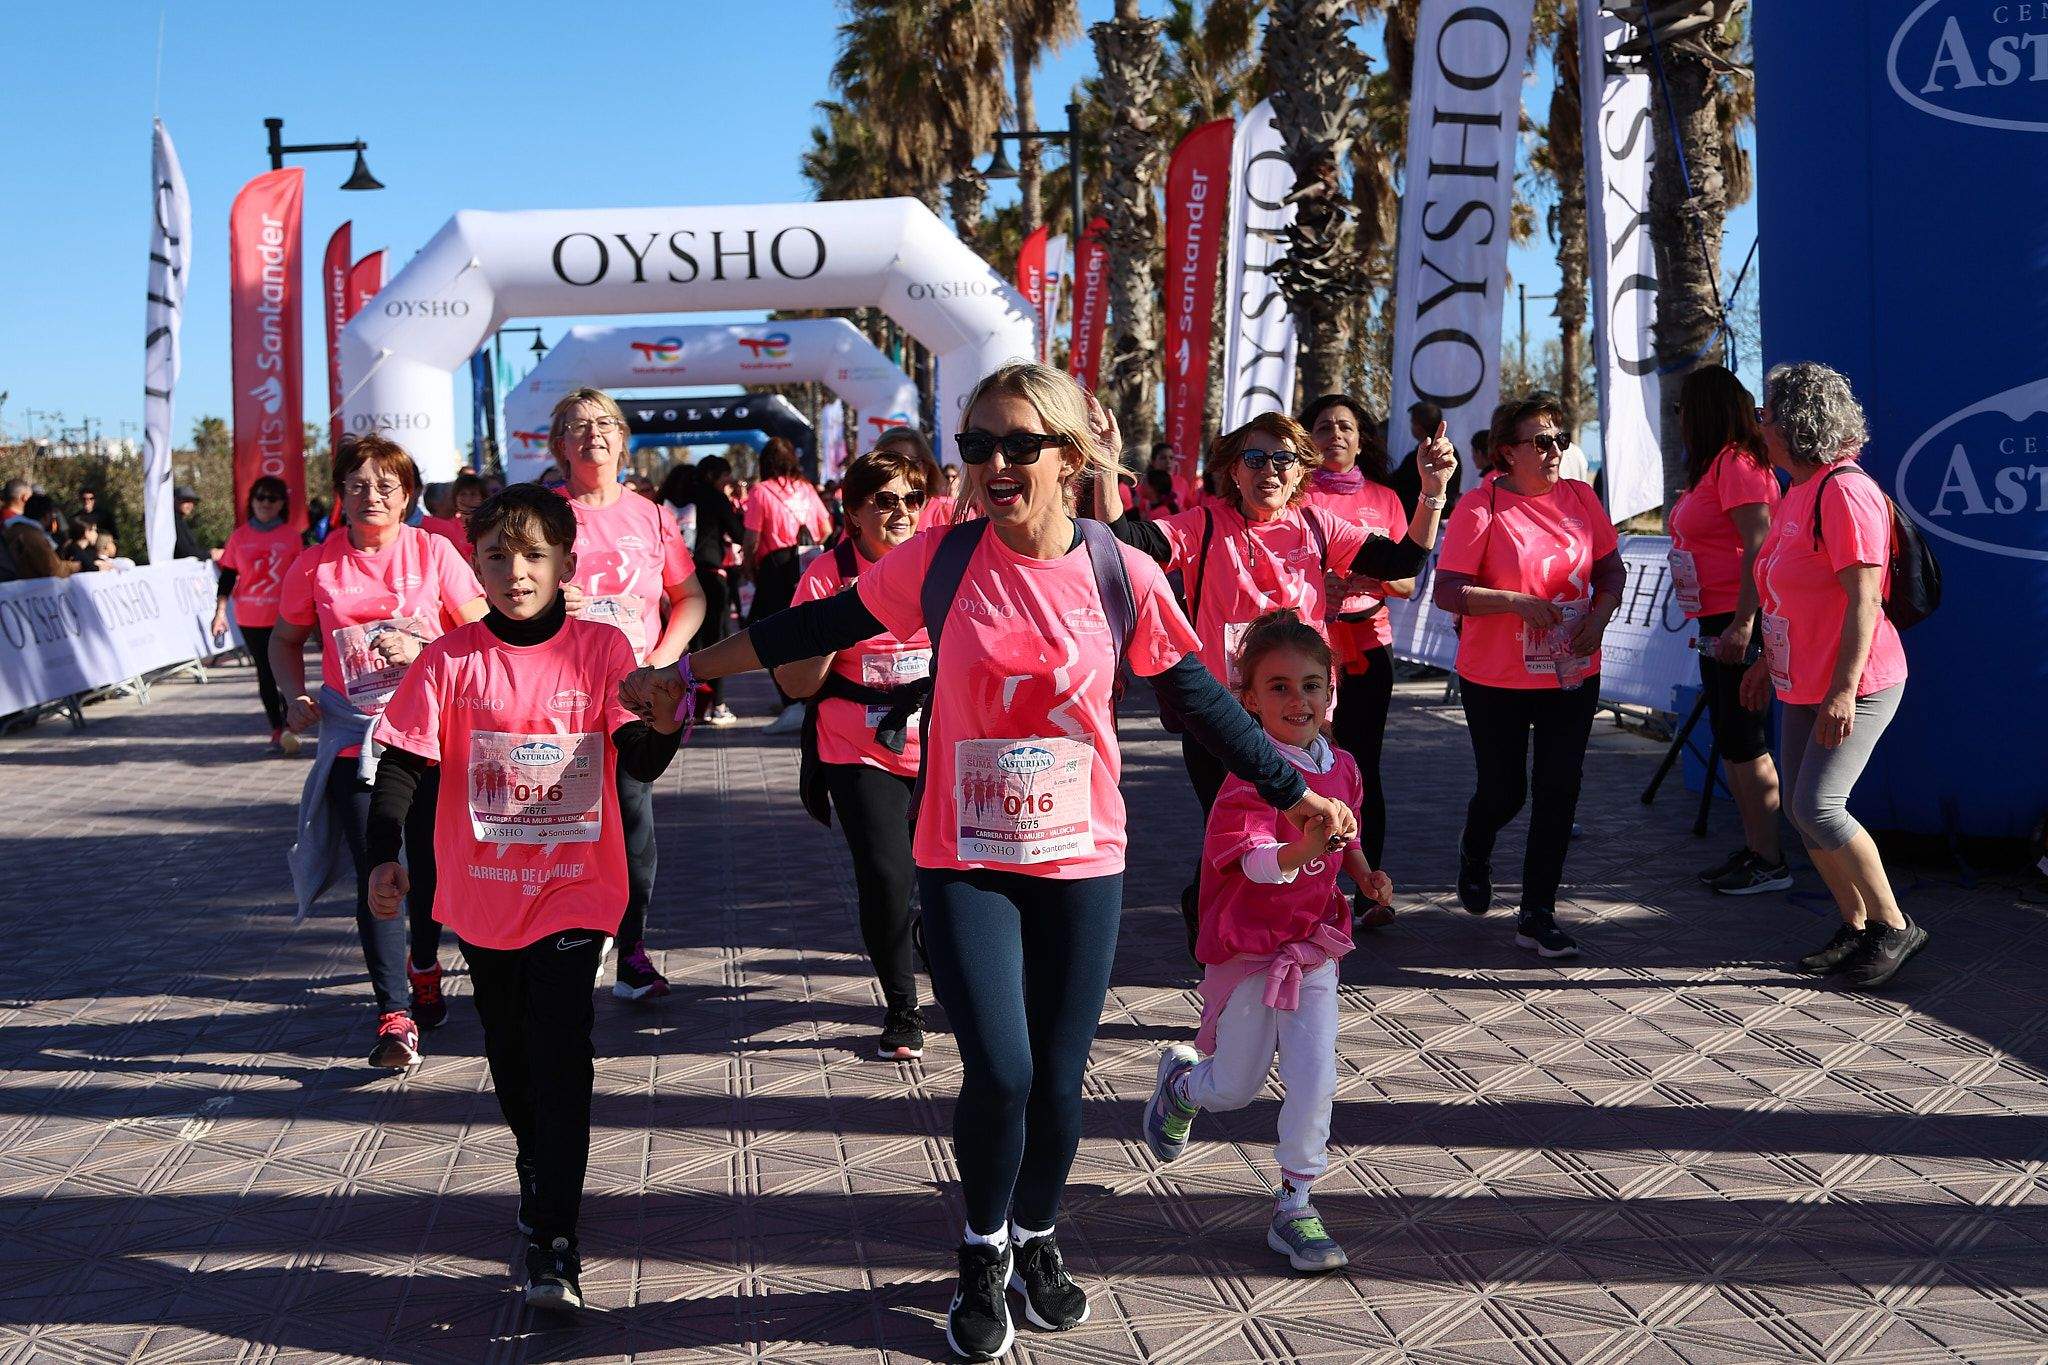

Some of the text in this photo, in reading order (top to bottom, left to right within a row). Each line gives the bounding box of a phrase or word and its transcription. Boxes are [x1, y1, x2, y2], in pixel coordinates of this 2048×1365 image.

[1409, 6, 1511, 410] OYSHO
[552, 225, 827, 287] OYSHO
[1179, 168, 1209, 333] Santander
[907, 281, 988, 301] OYSHO
[385, 300, 470, 318] OYSHO
[1074, 247, 1105, 369] Santander
[256, 212, 286, 480] orts Santander
[352, 411, 431, 431] OYSHO
[637, 406, 750, 422] VOLVO
[92, 579, 160, 631] OYSHO
[958, 597, 1015, 620] OYSHO
[0, 592, 81, 649] OYSHO
[513, 750, 561, 761] ASTURIANA
[1001, 757, 1051, 769] ASTURIANA
[514, 784, 564, 802] 016
[523, 806, 548, 816] 7676
[1003, 792, 1054, 816] 016
[485, 815, 513, 824] CARRERA
[557, 814, 585, 823] VALENCIA
[1014, 820, 1039, 832] 7675
[483, 826, 524, 838] OYSHO
[547, 828, 587, 836] Santander
[975, 826, 1076, 840] CARRERA DE LA MUJER VALENCIA
[973, 842, 1016, 857] OYSHO
[1041, 841, 1079, 855] Santander
[467, 864, 518, 883] CARRERA
[521, 868, 537, 883] DE
[537, 869, 550, 884] LA
[522, 883, 542, 896] 2025
